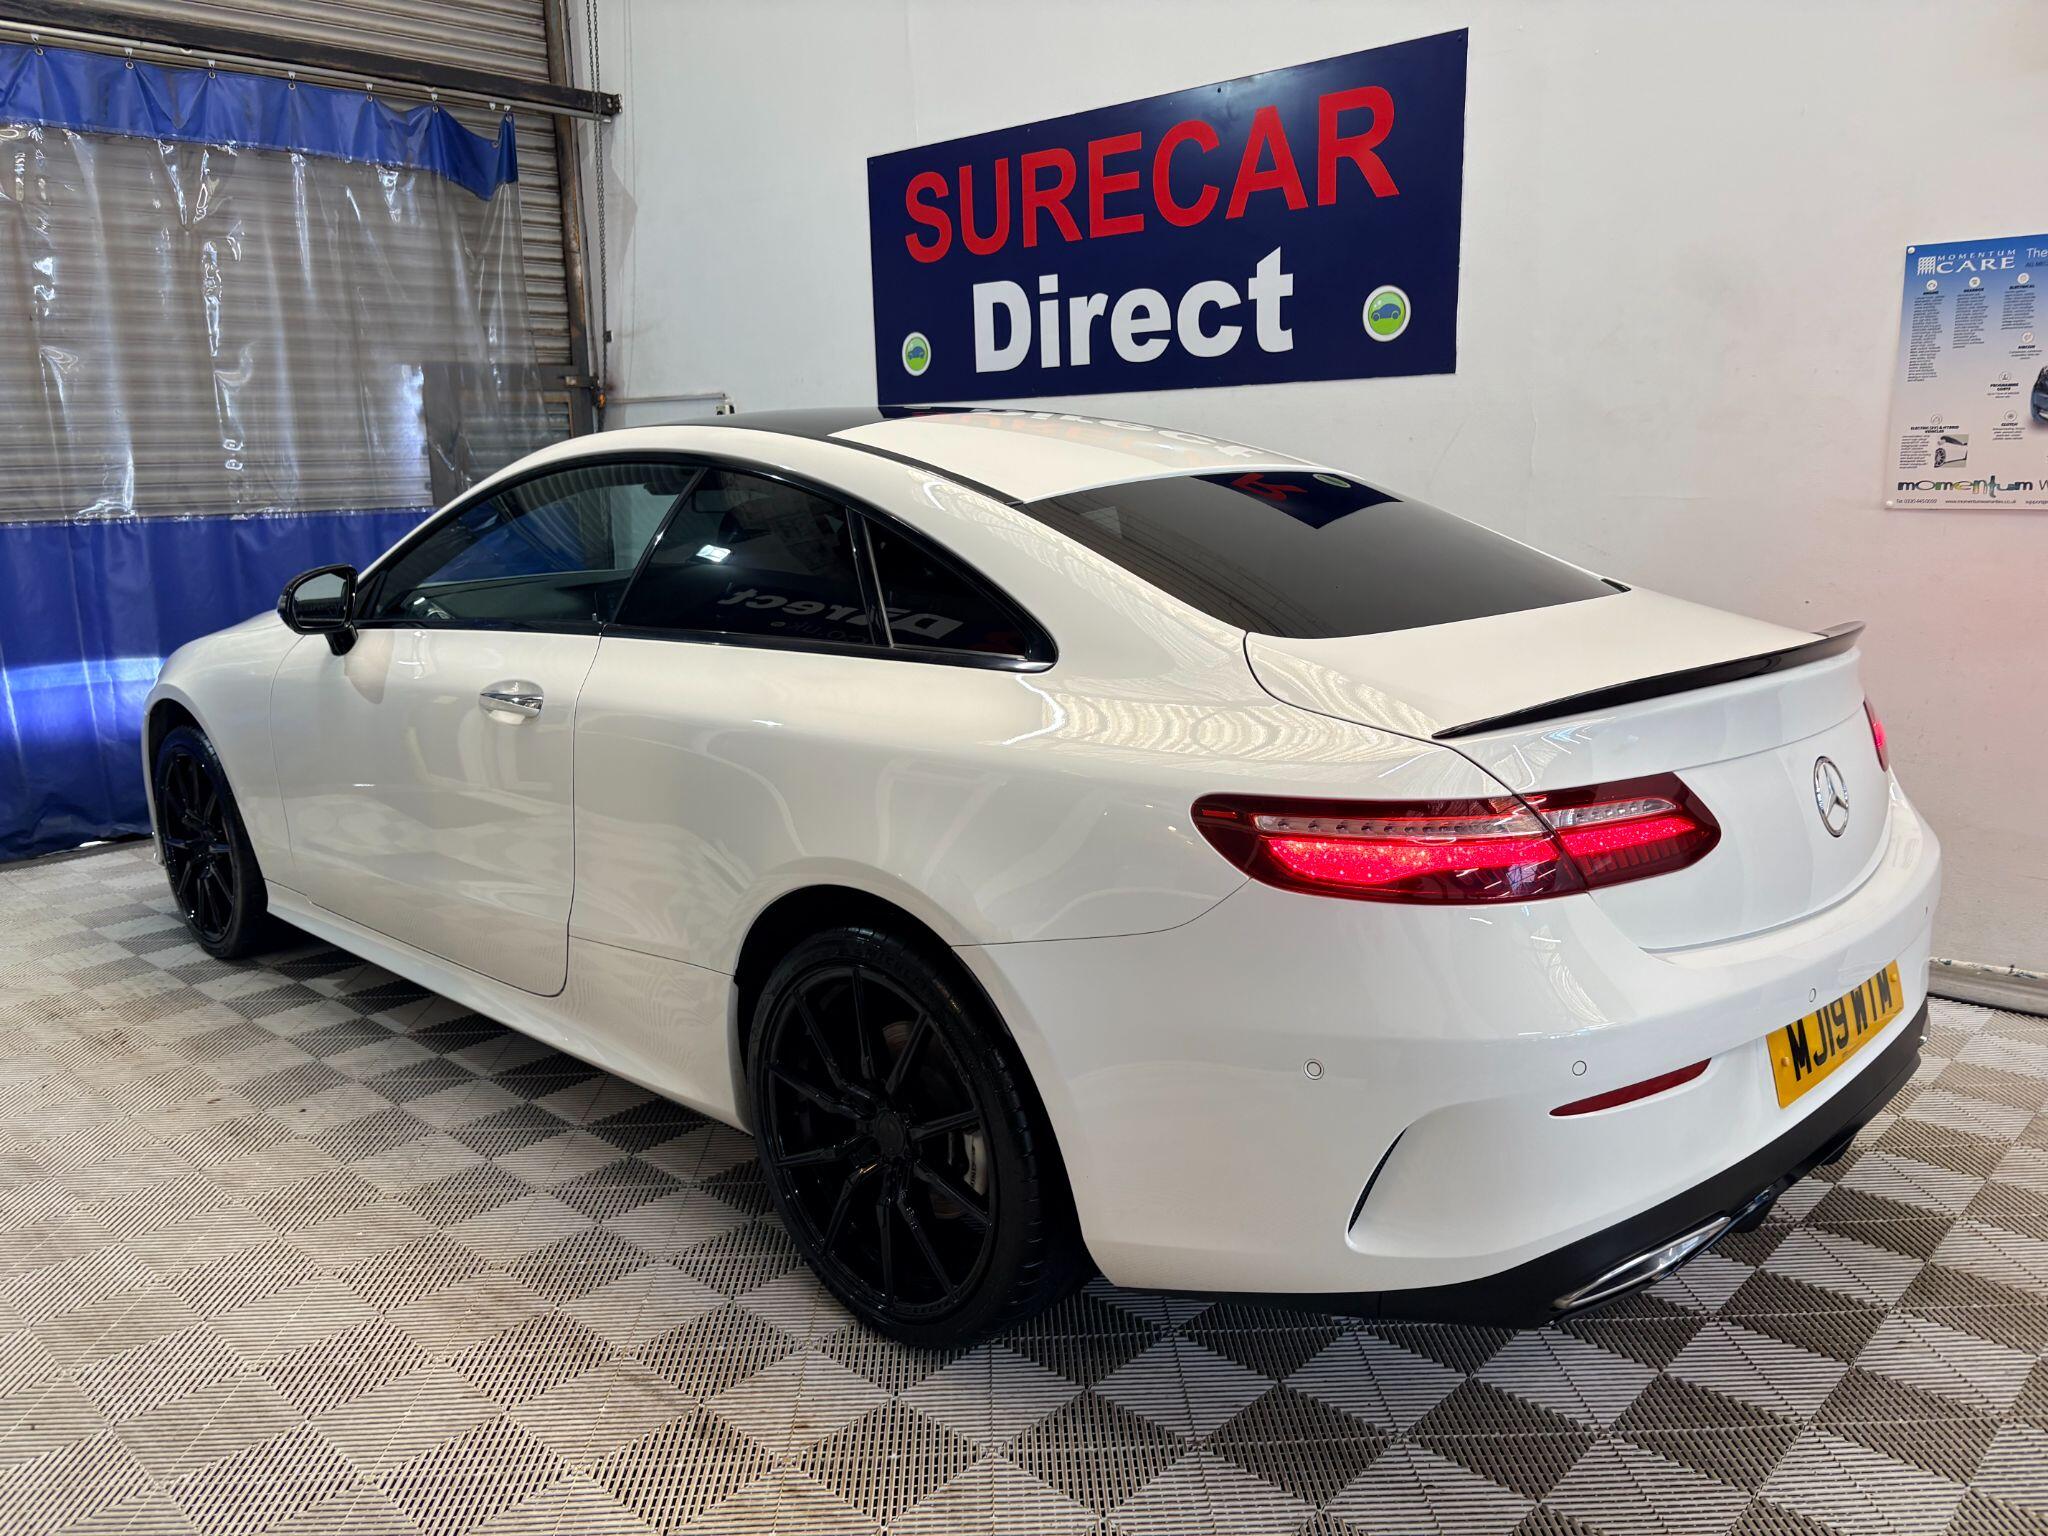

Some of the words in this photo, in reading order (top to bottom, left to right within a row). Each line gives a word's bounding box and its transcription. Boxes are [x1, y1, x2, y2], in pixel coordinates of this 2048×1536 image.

[904, 85, 1400, 263] SURECAR
[1937, 249, 2016, 261] MOMENTUM
[2026, 247, 2048, 258] The
[1936, 256, 2016, 274] CARE
[972, 245, 1294, 374] Direct
[1897, 475, 2033, 498] momentum
[1785, 997, 1849, 1082] MJ19
